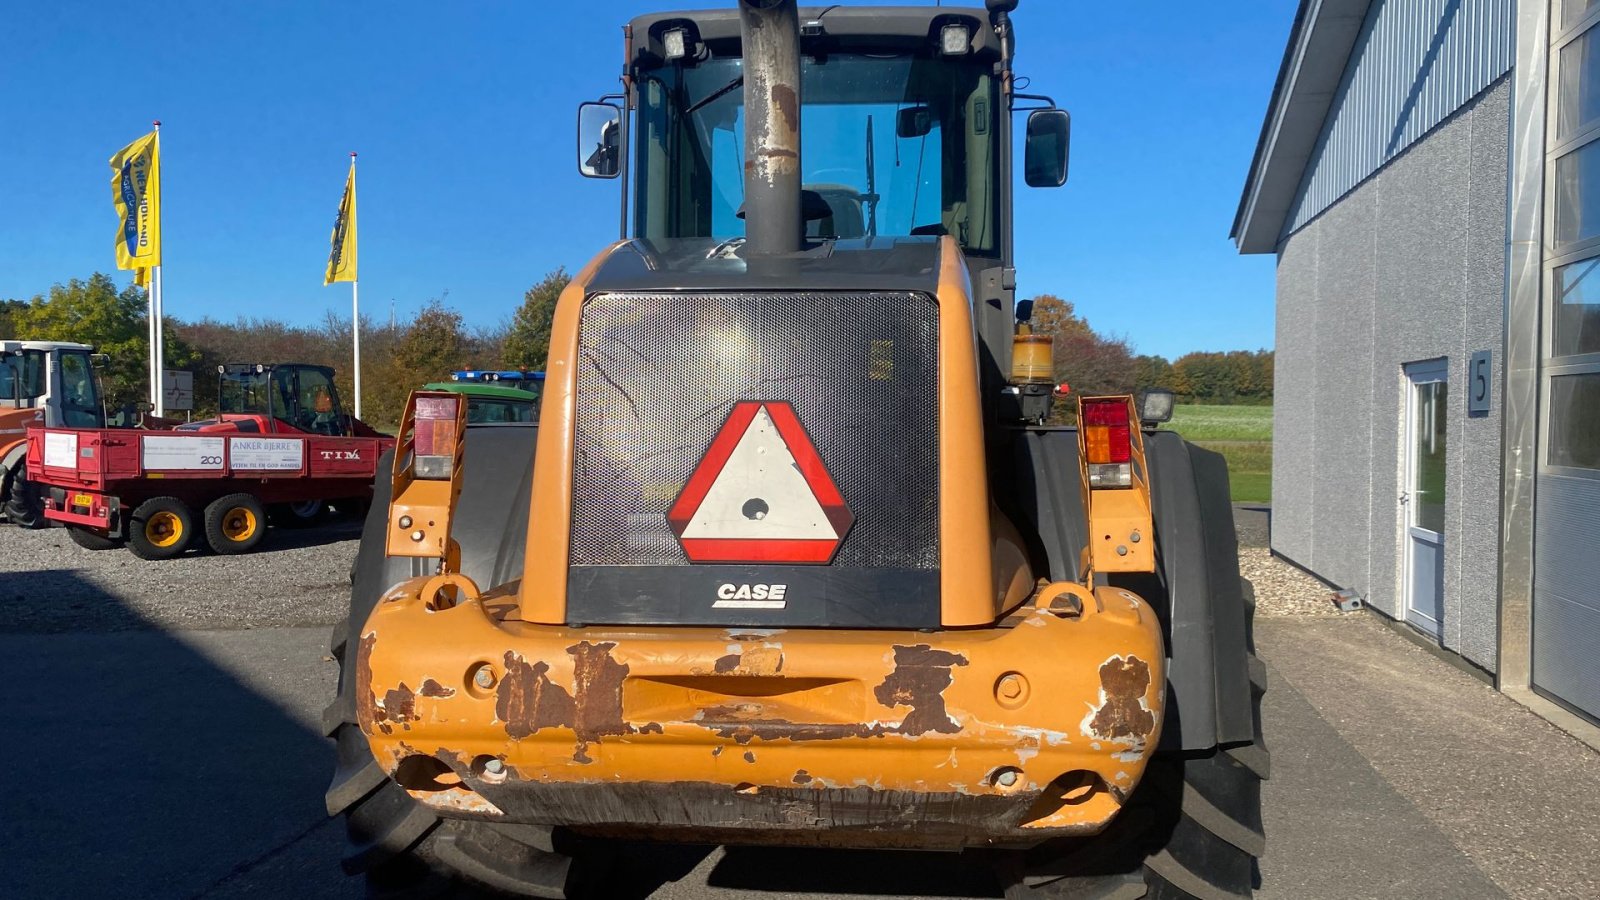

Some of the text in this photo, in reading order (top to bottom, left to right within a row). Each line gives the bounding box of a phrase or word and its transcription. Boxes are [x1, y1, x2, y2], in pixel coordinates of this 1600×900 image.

[135, 169, 149, 247] NEW HOLLAND
[1476, 359, 1486, 402] 5
[232, 441, 262, 451] ANKER
[200, 455, 223, 465] 200
[320, 448, 361, 460] TIM
[717, 583, 787, 600] CASE
